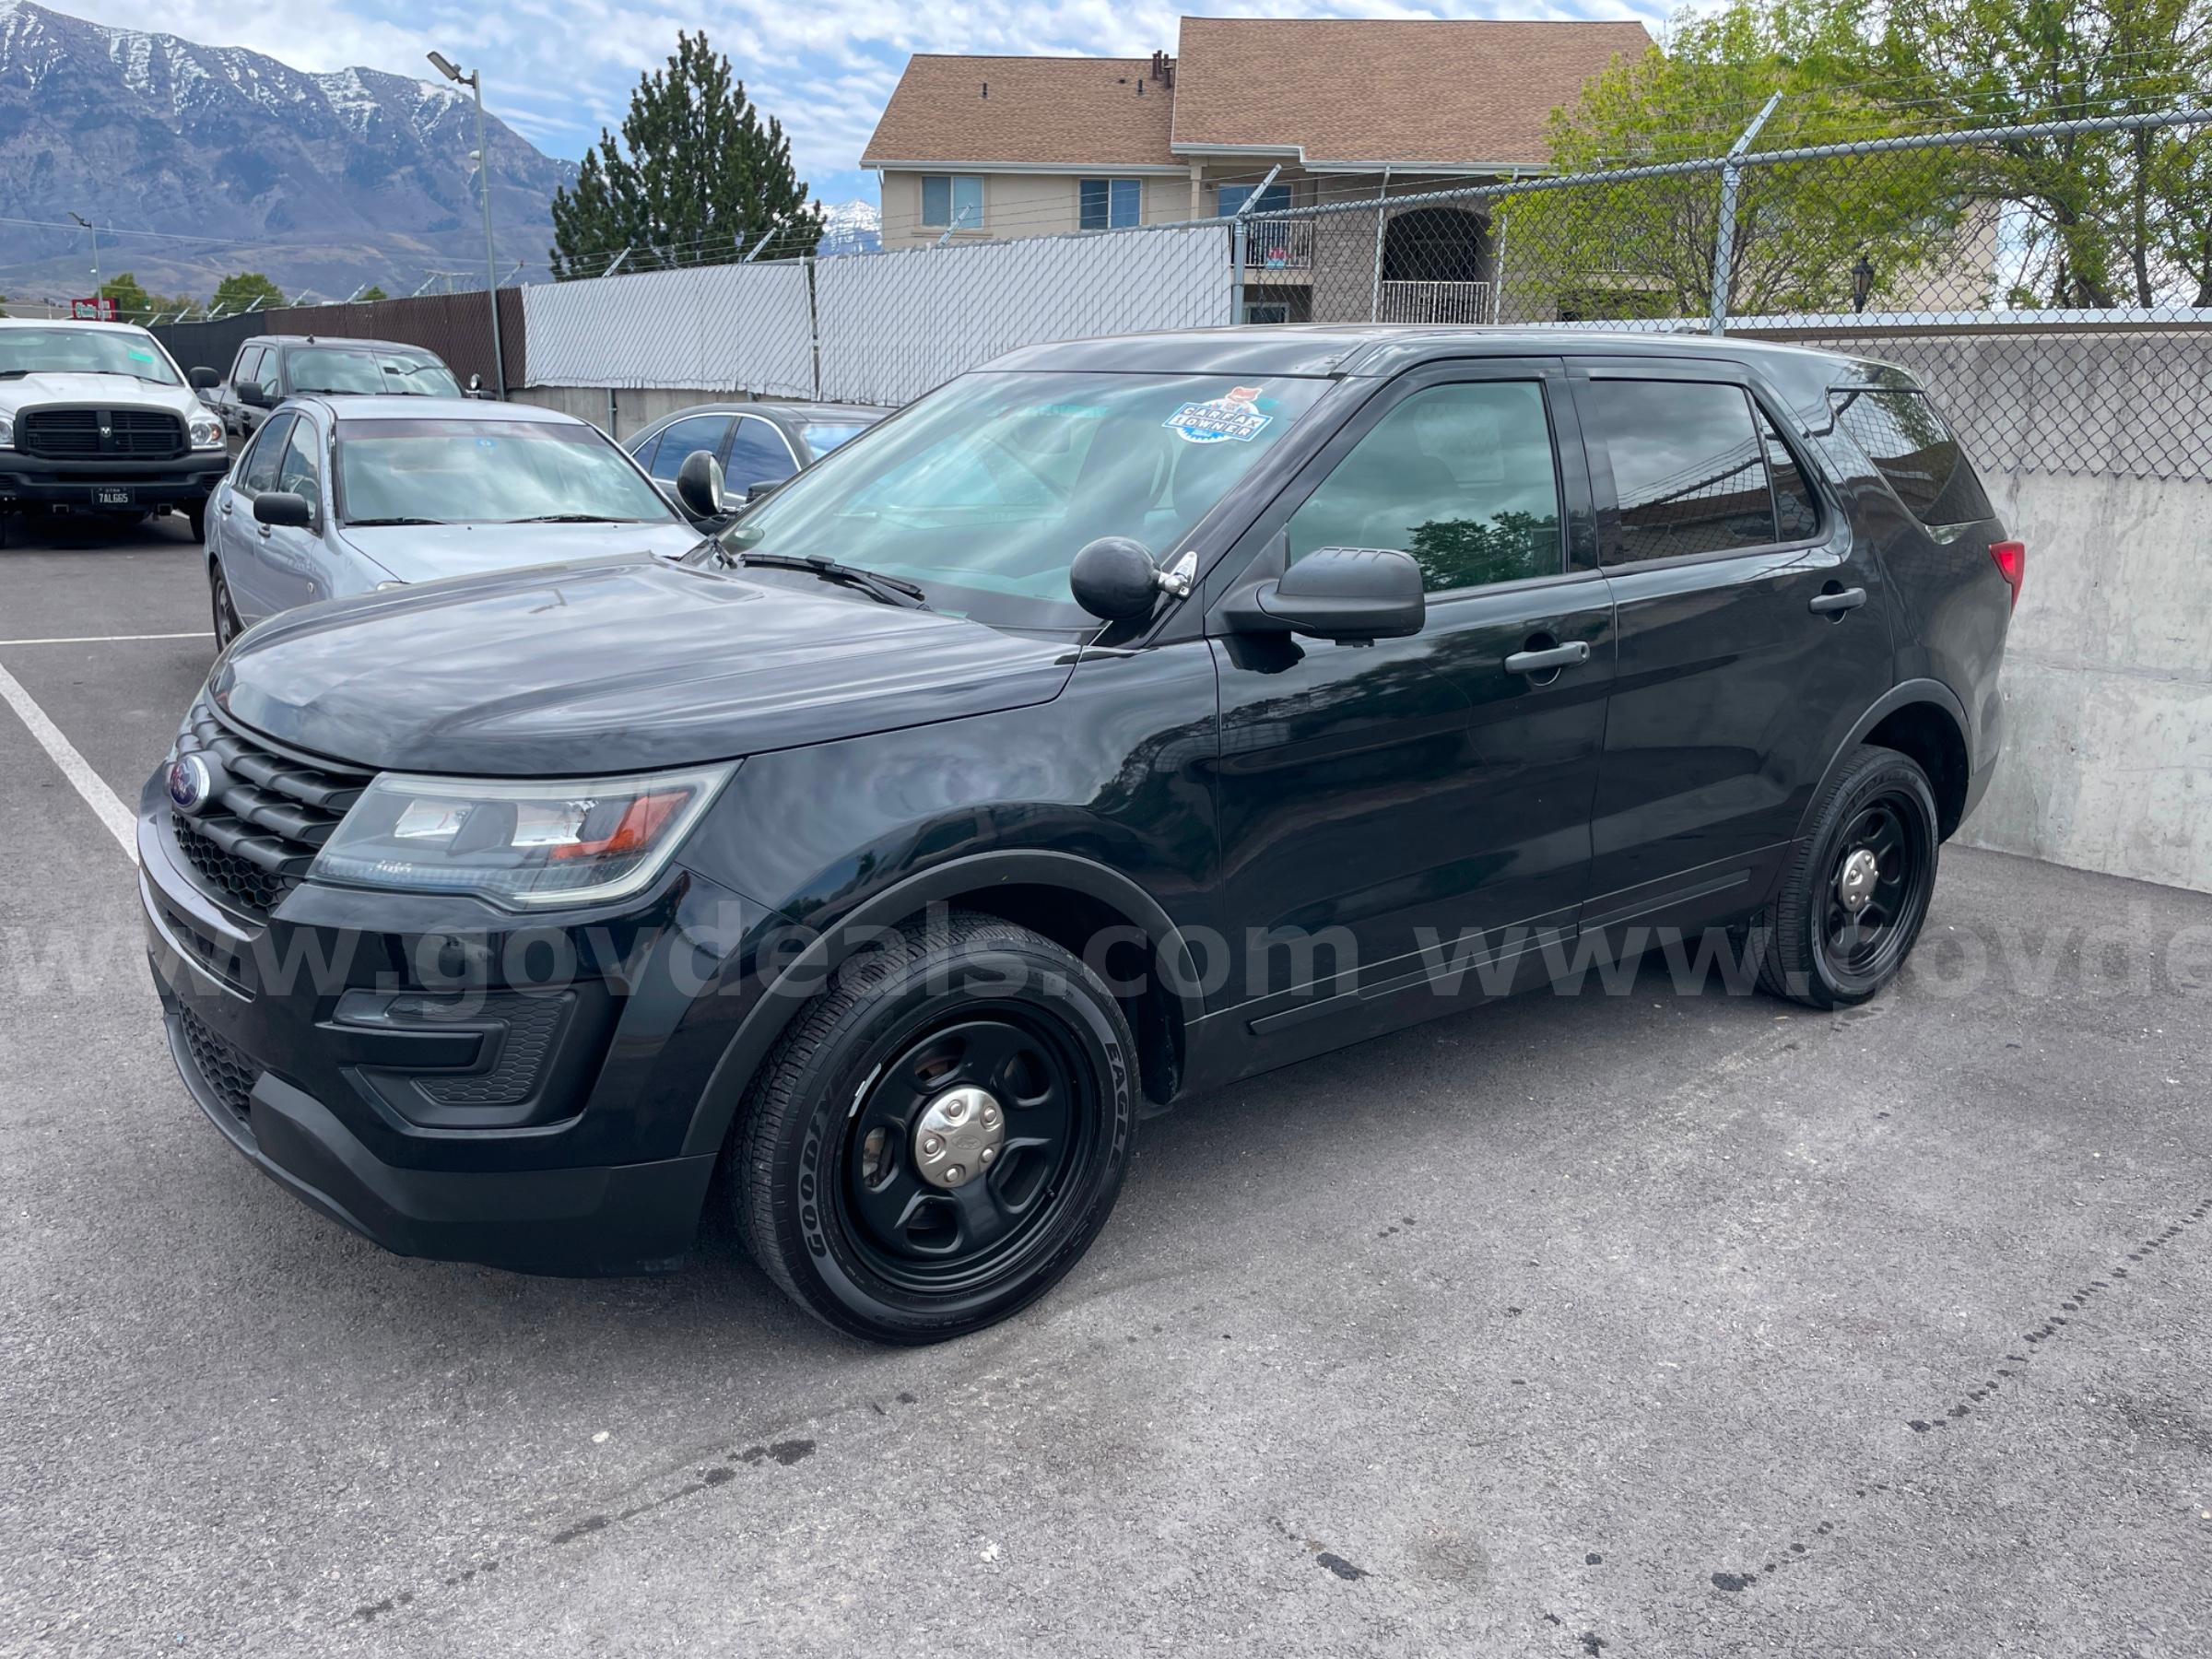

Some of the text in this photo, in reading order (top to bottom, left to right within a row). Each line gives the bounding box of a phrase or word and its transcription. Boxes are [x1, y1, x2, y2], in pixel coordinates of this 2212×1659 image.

[1183, 406, 1260, 428] CARFAX
[1185, 418, 1252, 436] OWNER
[1105, 1042, 1128, 1172] EAGLE
